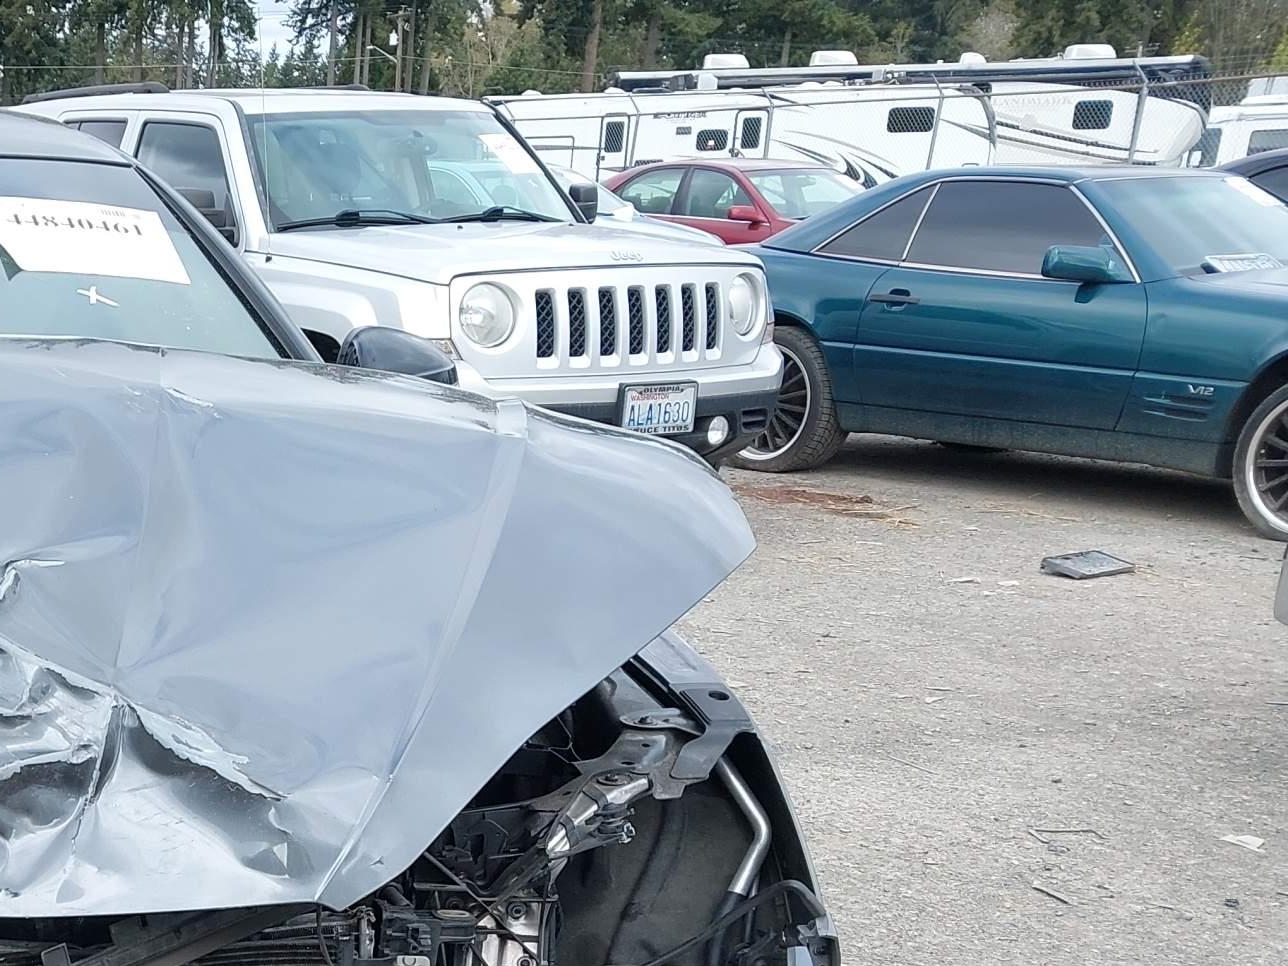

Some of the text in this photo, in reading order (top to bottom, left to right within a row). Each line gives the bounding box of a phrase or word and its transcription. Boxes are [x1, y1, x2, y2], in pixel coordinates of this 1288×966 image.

[6, 213, 144, 236] 44840461
[643, 385, 682, 394] OLYMPIA
[1187, 384, 1215, 396] V12
[630, 392, 670, 402] WASHINGTON
[627, 400, 690, 427] ALA1630
